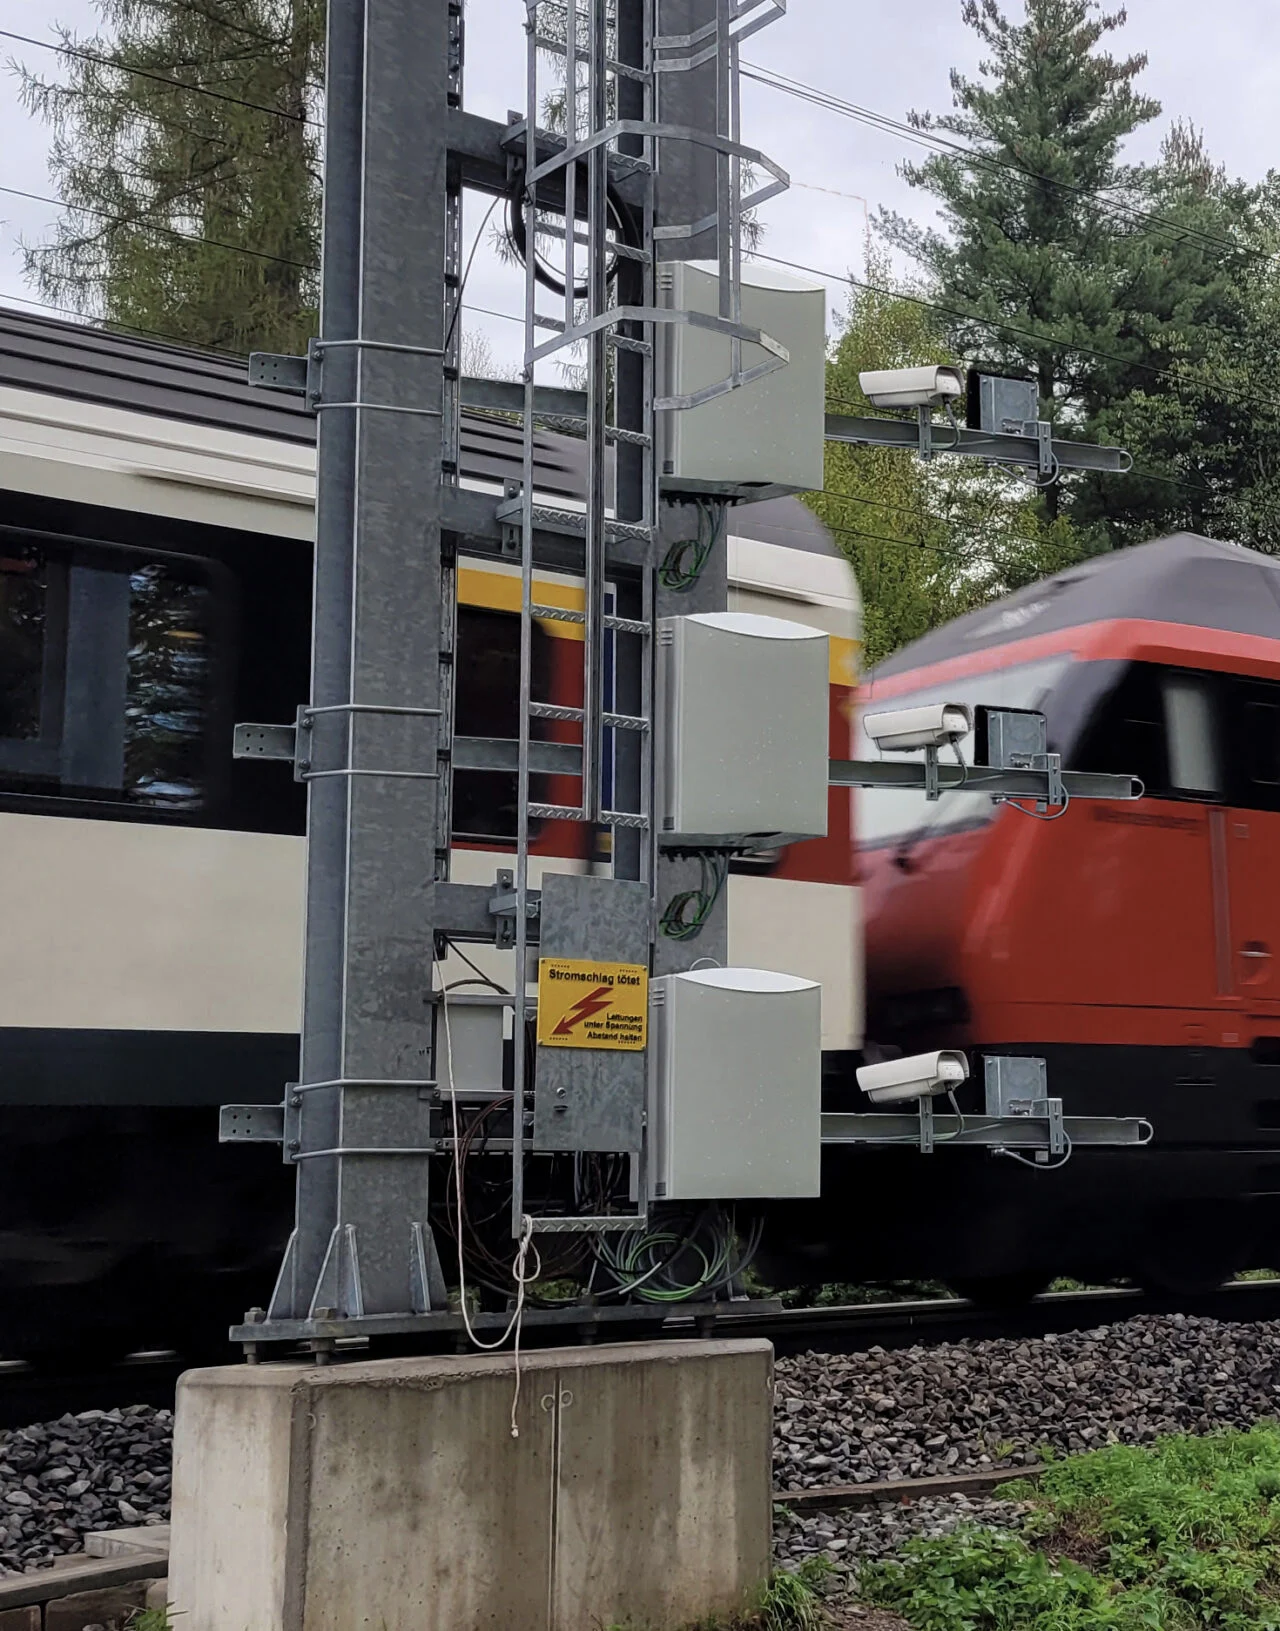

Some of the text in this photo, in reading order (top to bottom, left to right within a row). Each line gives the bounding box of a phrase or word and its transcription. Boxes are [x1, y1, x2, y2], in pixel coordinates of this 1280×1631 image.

[549, 969, 640, 986] Stromschlag tötet
[606, 1013, 643, 1023] Leitungen
[584, 1021, 643, 1032] unter Spannung
[587, 1031, 642, 1042] Abstand halten
